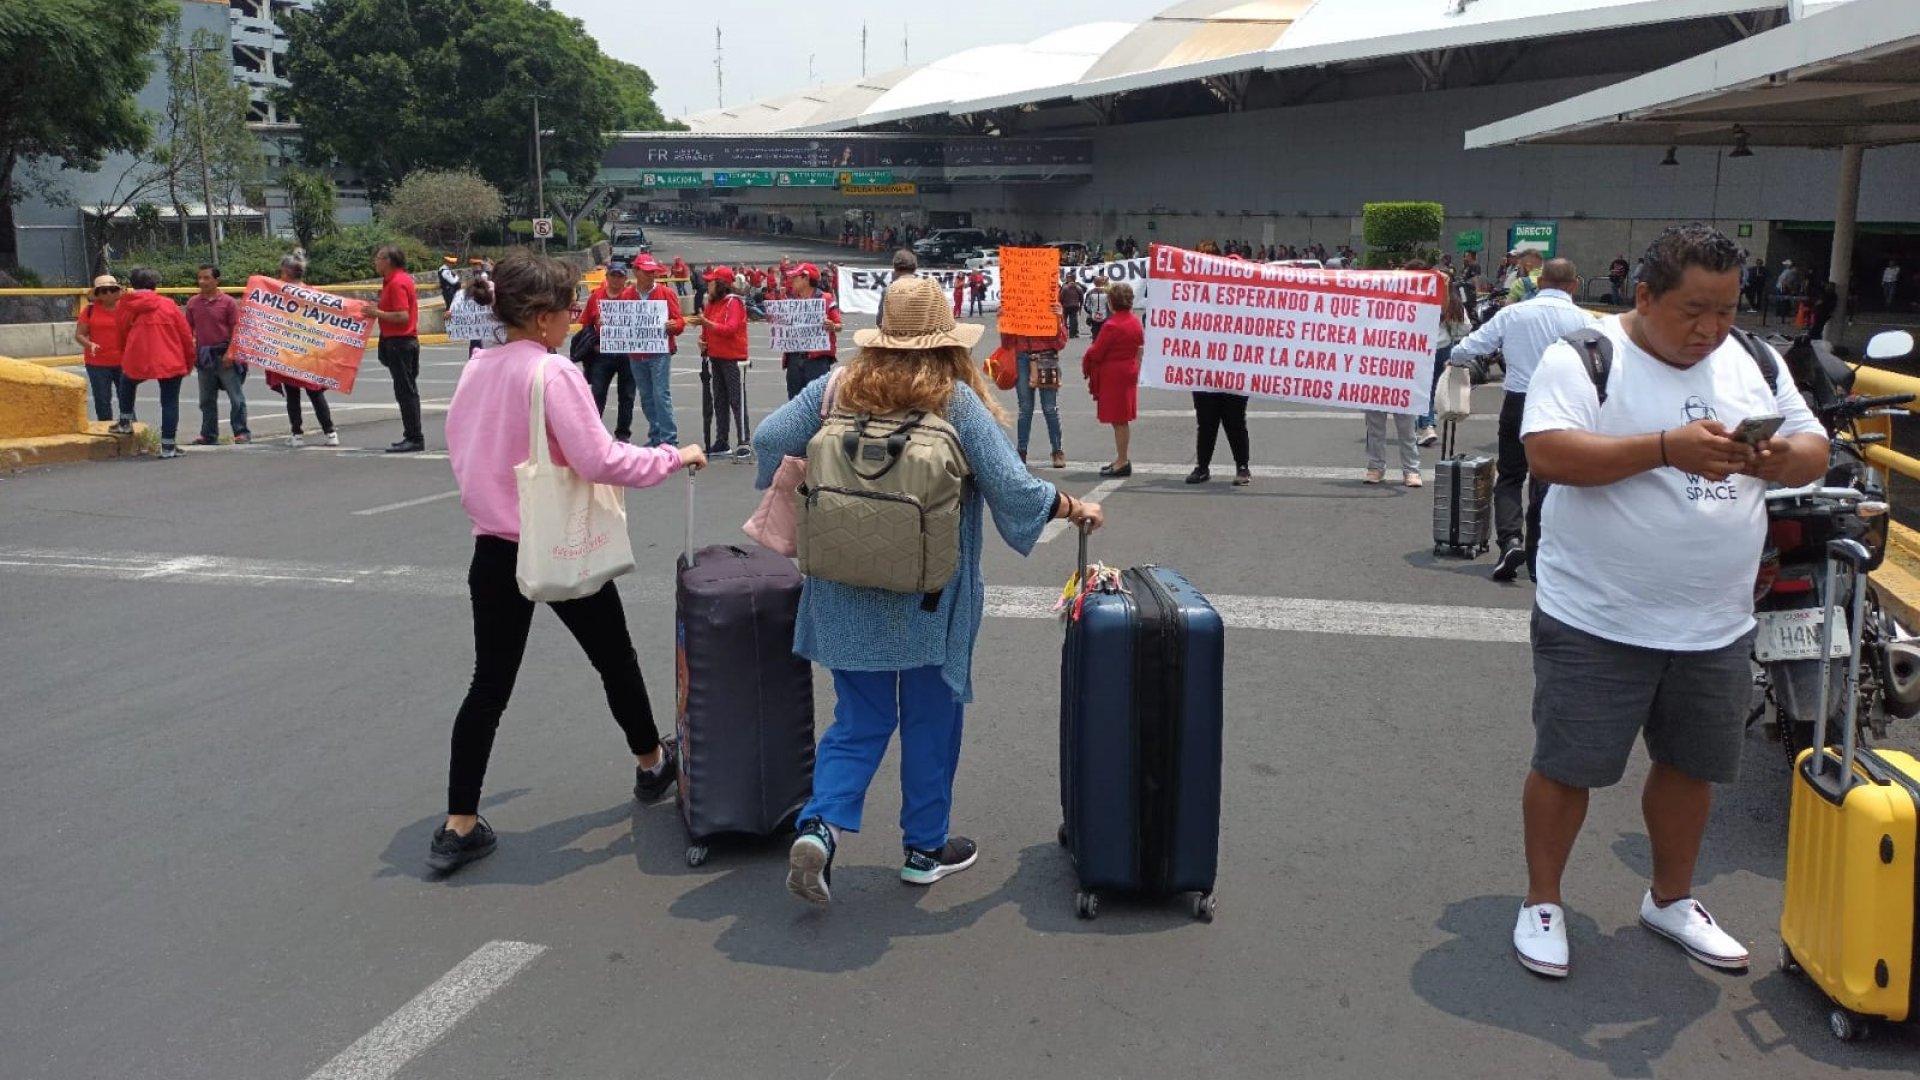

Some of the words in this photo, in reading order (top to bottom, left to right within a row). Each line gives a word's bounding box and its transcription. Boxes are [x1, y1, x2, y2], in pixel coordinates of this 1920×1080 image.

[648, 149, 668, 162] FR
[1516, 226, 1553, 236] DIRECTO
[1156, 248, 1176, 273] EL
[1181, 252, 1255, 279] SINDICO
[1260, 263, 1329, 286] MIGUEL
[1335, 269, 1438, 297] ESCAMILLA
[249, 288, 299, 313] AMLO
[281, 284, 343, 310] FICREA
[1171, 282, 1210, 302] ESTA
[1216, 286, 1310, 311] ESPERANDO
[1313, 294, 1324, 313] A
[1330, 297, 1361, 318] QUE
[1367, 299, 1417, 323] TODOS
[1150, 308, 1177, 329] LOS
[1180, 311, 1296, 339] AHORRADORES
[1301, 321, 1357, 345] FICREA
[1362, 327, 1433, 356] MUERAN,
[1162, 337, 1201, 359] PARA
[1206, 341, 1228, 361] NO
[1232, 344, 1264, 365] DAR
[1269, 346, 1289, 367] LA
[1294, 349, 1337, 372] CARA
[1343, 353, 1354, 373] Y
[1358, 355, 1416, 380] SEGUIR
[1164, 365, 1246, 391] GASTANDO
[1250, 373, 1333, 400] NUESTROS
[1337, 382, 1411, 408] AHORROS
[1685, 485, 1738, 501] SPACE
